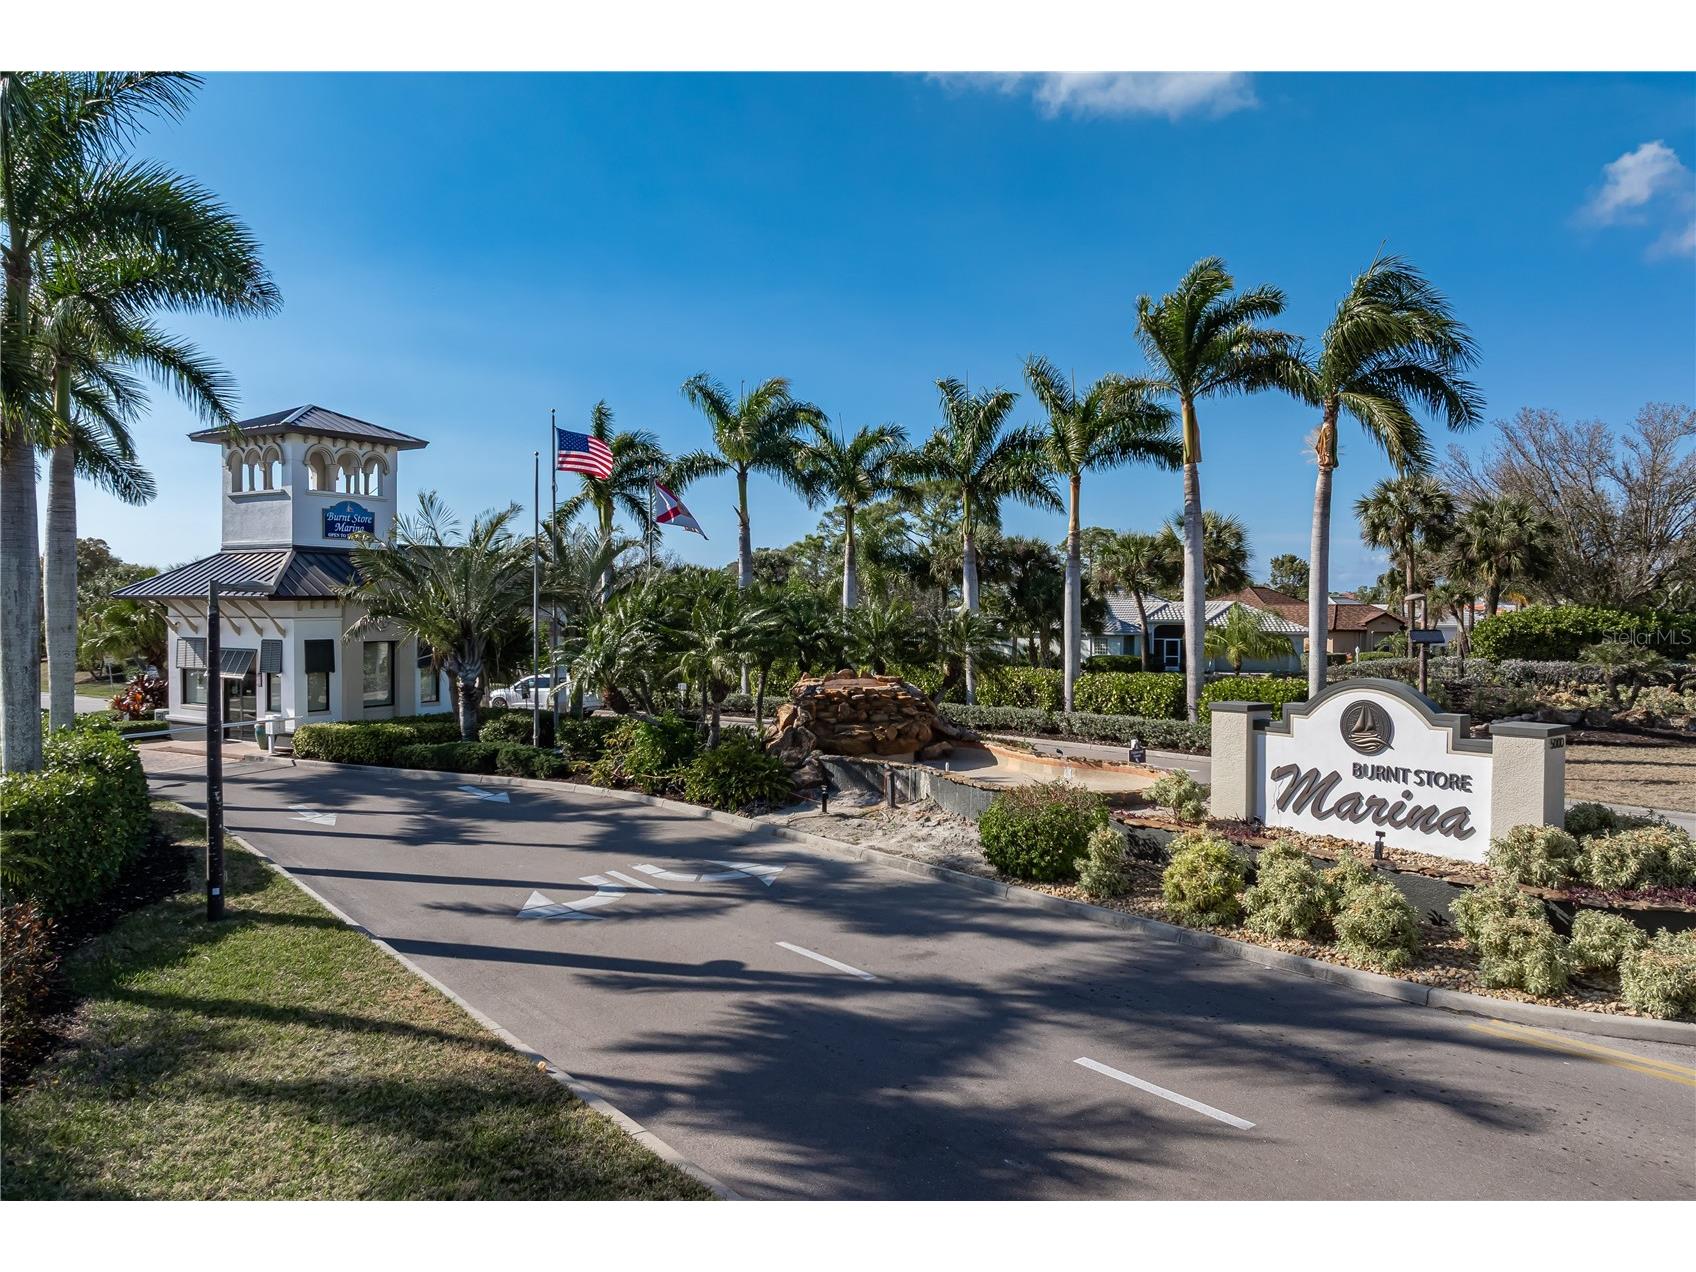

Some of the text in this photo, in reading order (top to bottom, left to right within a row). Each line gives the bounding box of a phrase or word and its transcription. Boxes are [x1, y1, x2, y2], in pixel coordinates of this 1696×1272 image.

[327, 512, 373, 524] Burnt Store
[334, 522, 365, 532] Marina
[1352, 761, 1473, 793] BURNT STORE
[1270, 763, 1476, 840] Marina
